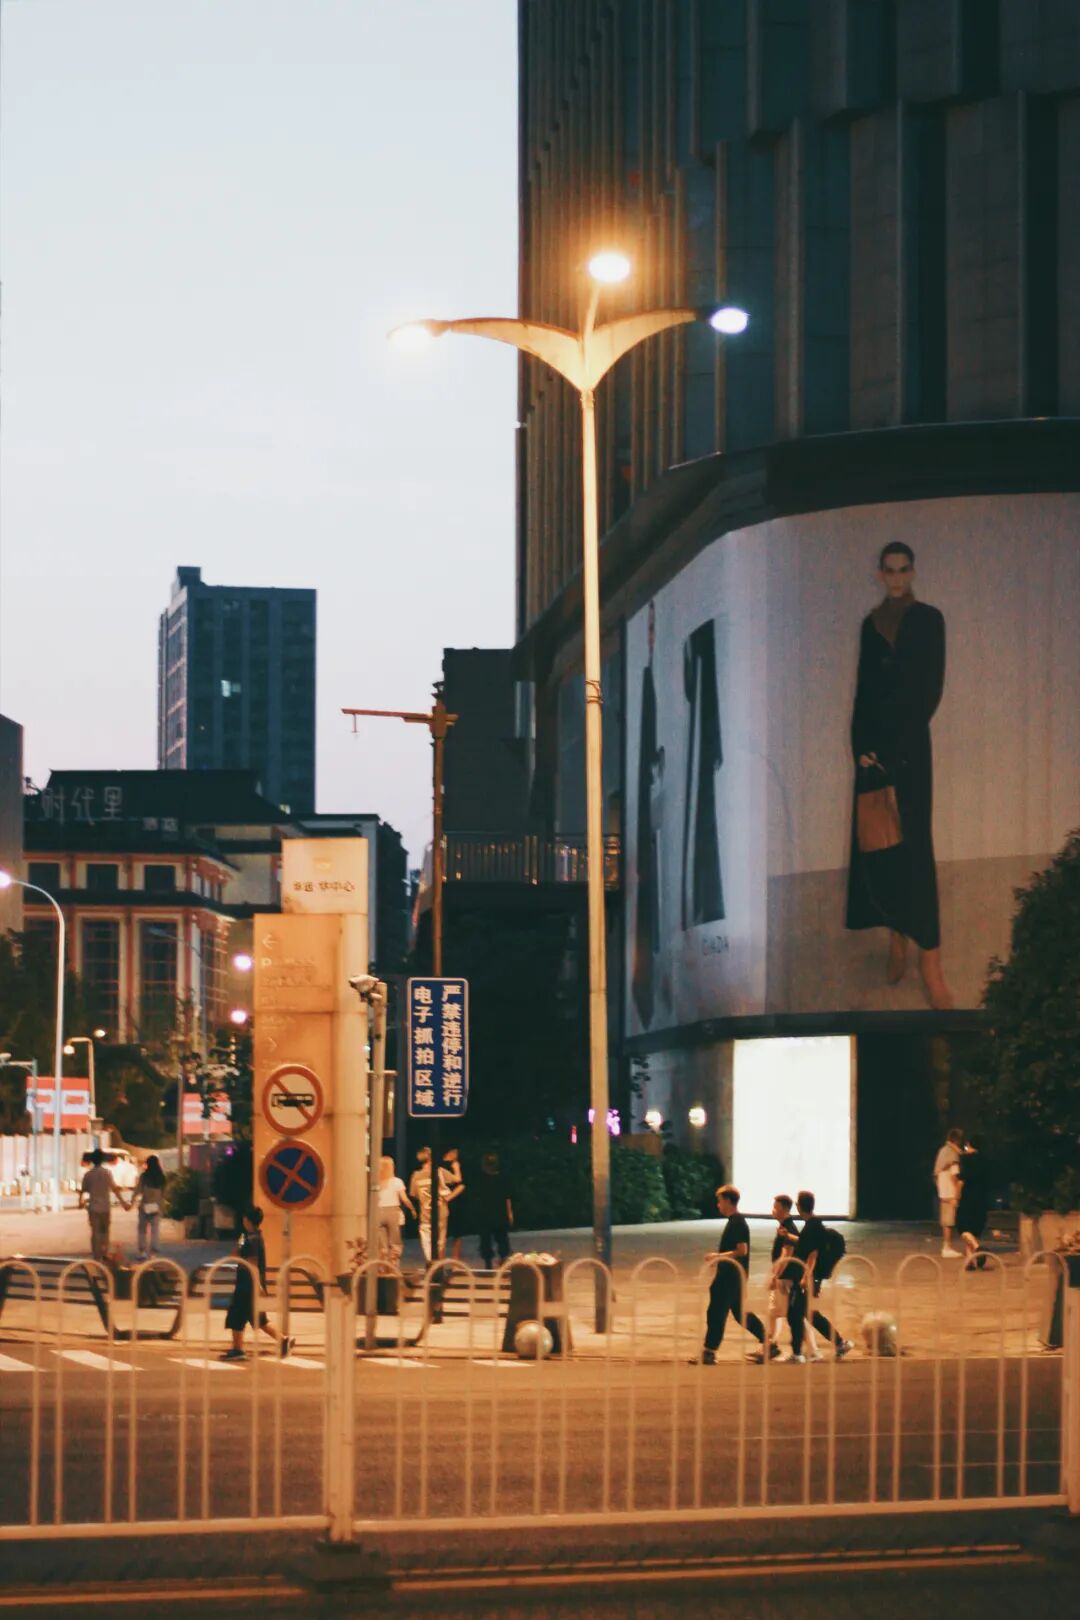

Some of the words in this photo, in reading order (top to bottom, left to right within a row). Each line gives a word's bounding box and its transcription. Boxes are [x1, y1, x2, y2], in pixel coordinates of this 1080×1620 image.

[42, 786, 123, 826] 时代里
[413, 985, 435, 1108] 电子抓拍区域
[441, 984, 463, 1107] 严禁违停和逆行
